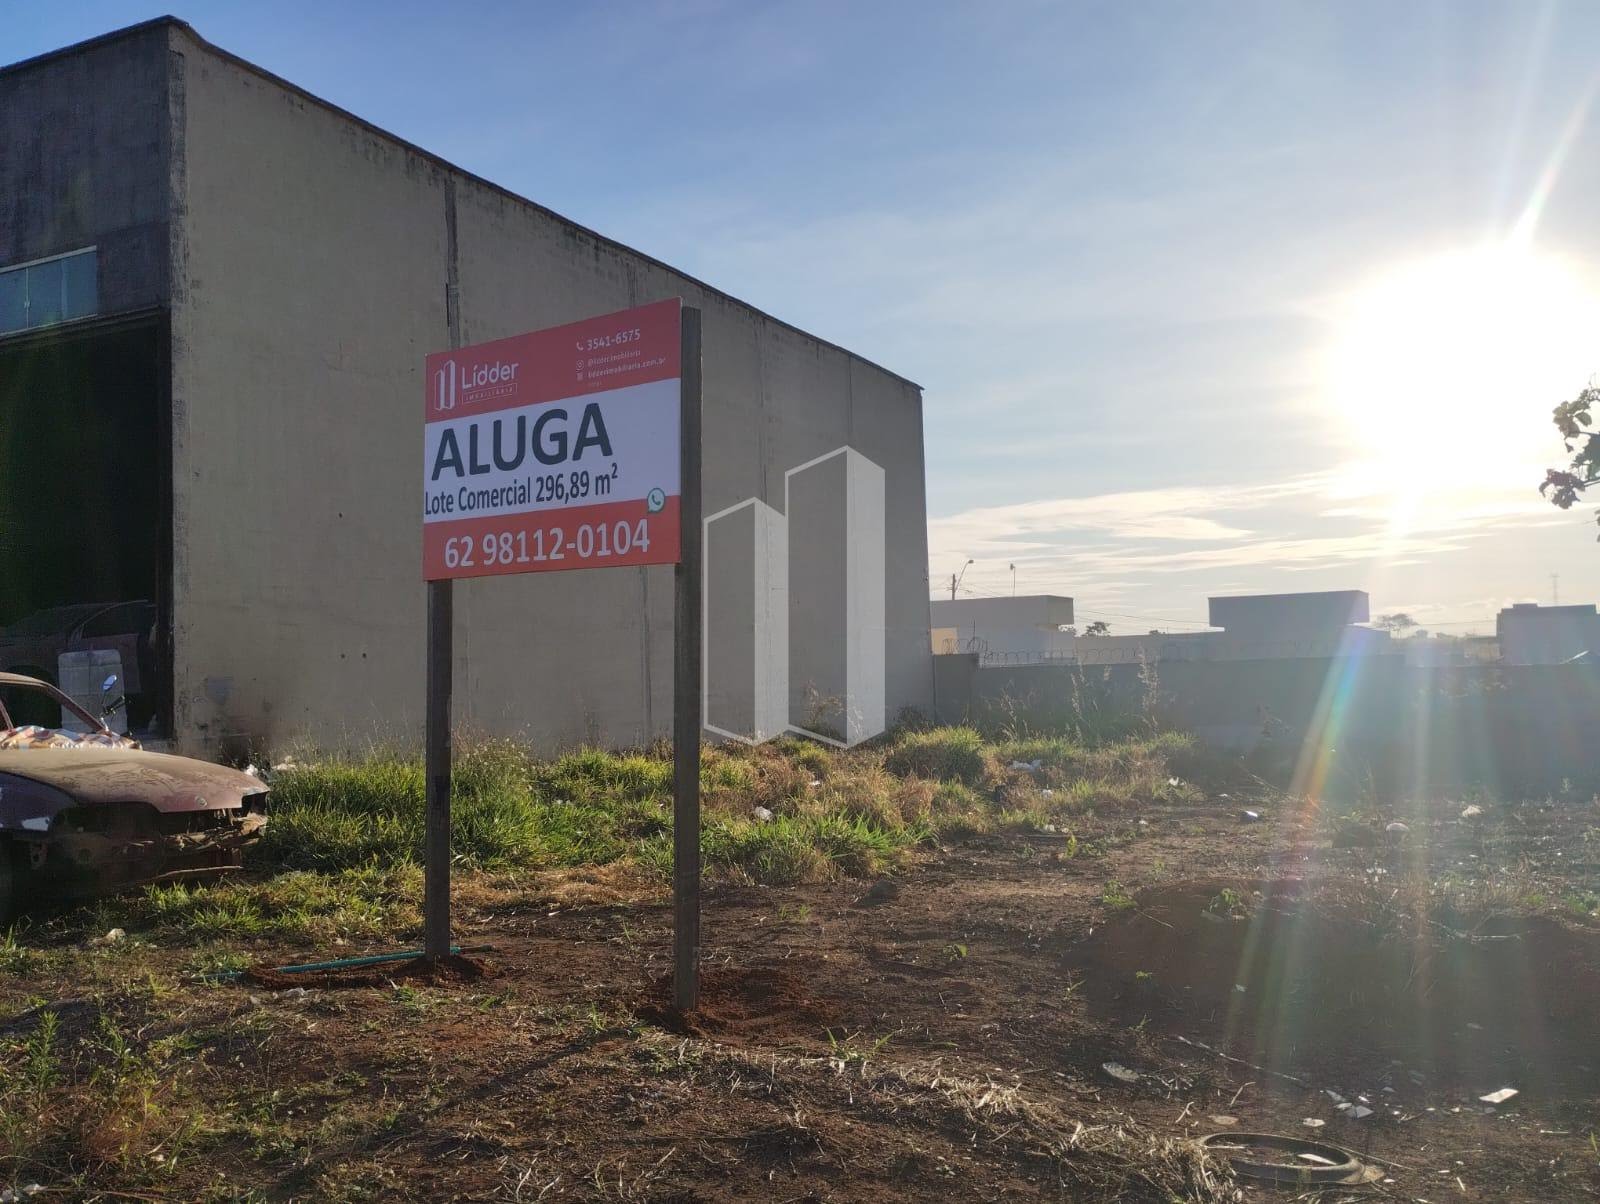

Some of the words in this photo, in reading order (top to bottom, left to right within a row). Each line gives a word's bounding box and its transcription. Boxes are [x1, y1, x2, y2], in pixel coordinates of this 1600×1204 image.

[587, 329, 641, 351] 3541-6575
[461, 361, 519, 389] Lídder
[431, 403, 613, 481] ALUGA
[425, 491, 454, 515] Lote
[458, 477, 531, 512] Comercial
[535, 470, 590, 504] 296,89
[445, 537, 474, 569] 62
[482, 518, 650, 566] 98112-0104
